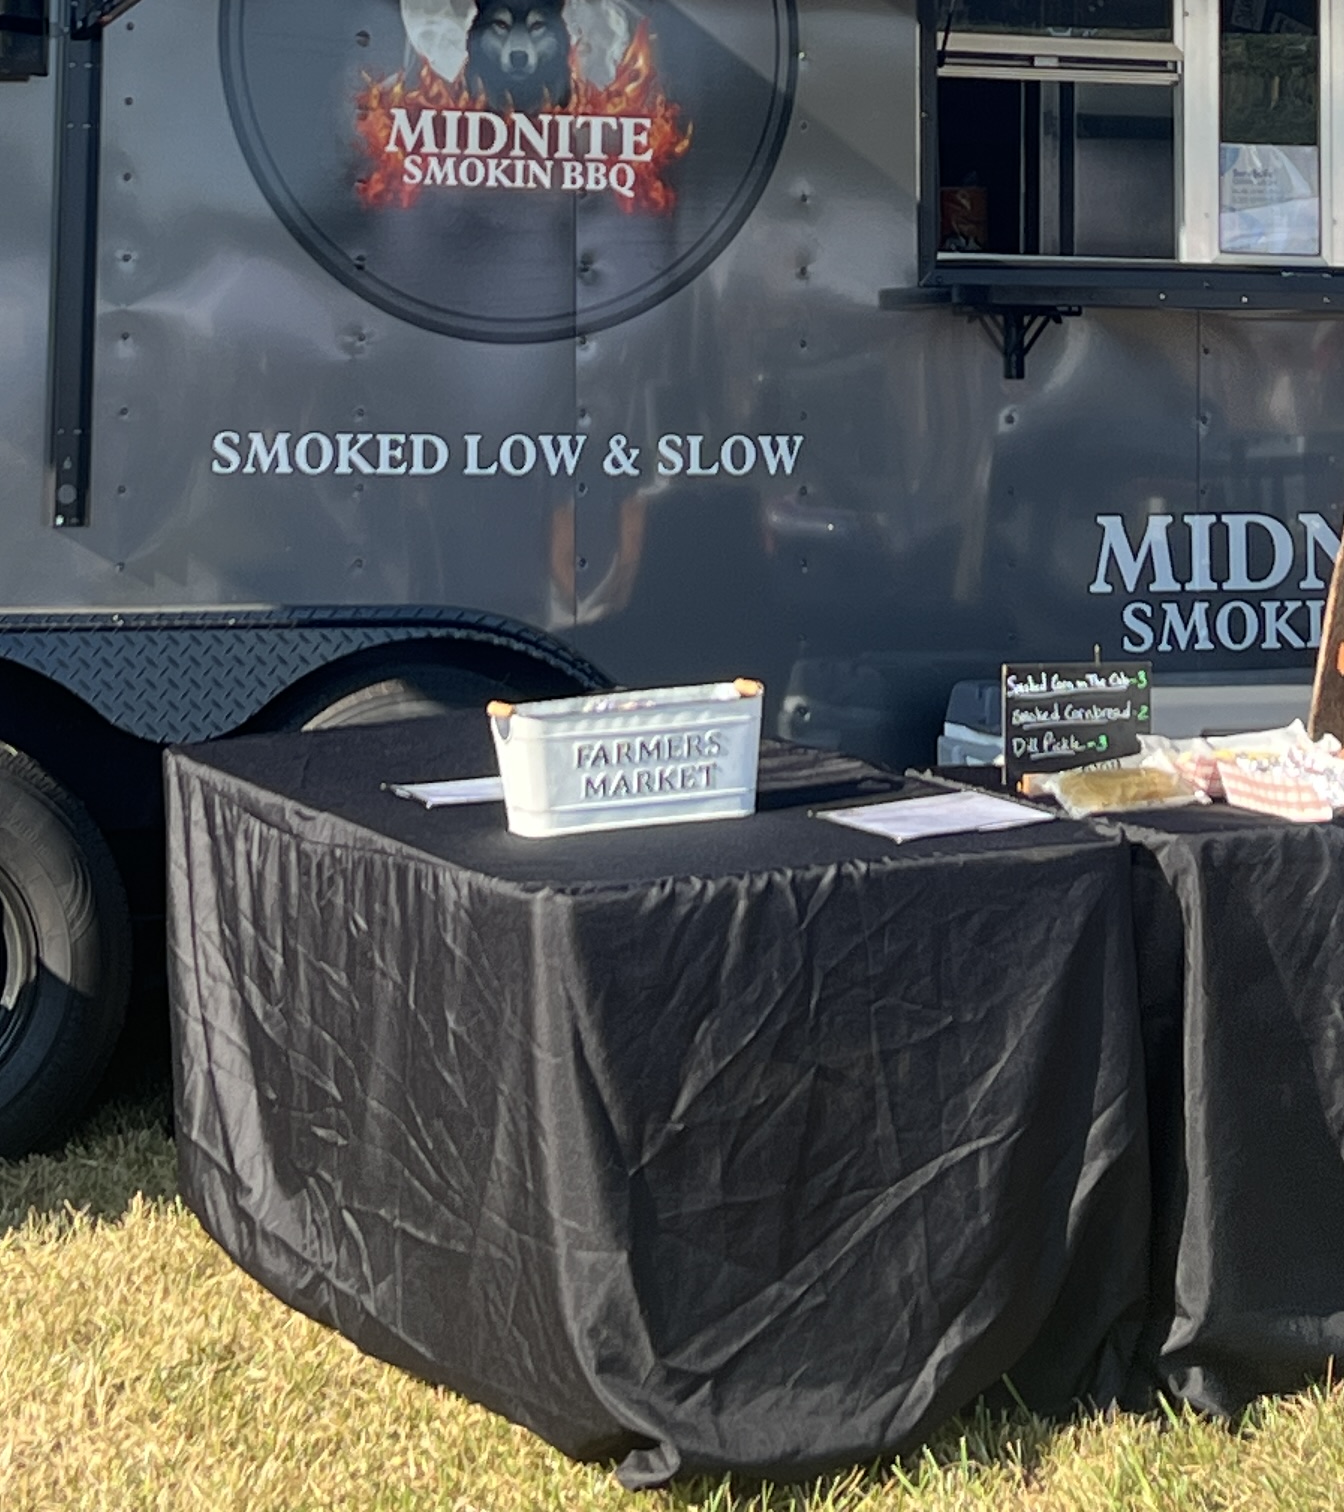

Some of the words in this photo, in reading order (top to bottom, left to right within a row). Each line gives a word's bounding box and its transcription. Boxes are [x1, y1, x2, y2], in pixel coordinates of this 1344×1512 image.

[385, 107, 654, 162] MIDNITE
[402, 155, 553, 189] SMOKIN
[561, 161, 636, 197] BBQ
[210, 431, 450, 476] SMOKED
[463, 433, 588, 476] LOW
[602, 433, 640, 476] &
[656, 433, 805, 477] SLOW
[1088, 513, 1344, 593] MIDN
[1122, 600, 1325, 653] SMOKI
[572, 728, 729, 769] FARMERS
[581, 760, 721, 799] MARKET
